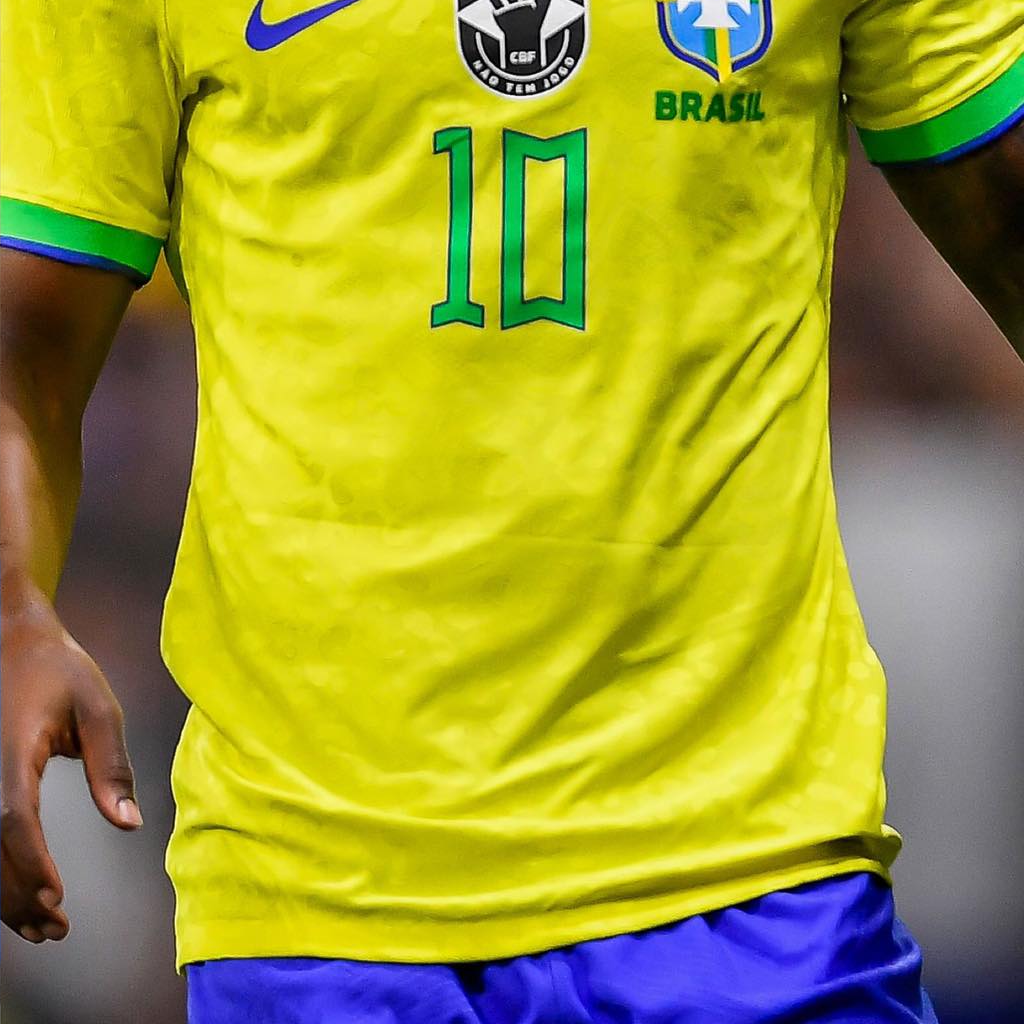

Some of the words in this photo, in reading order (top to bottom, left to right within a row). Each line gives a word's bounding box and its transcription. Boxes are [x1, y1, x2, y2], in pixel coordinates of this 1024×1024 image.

[509, 50, 536, 65] CBF
[506, 82, 537, 94] TEM
[655, 88, 765, 123] BRASIL
[431, 126, 587, 332] 10
